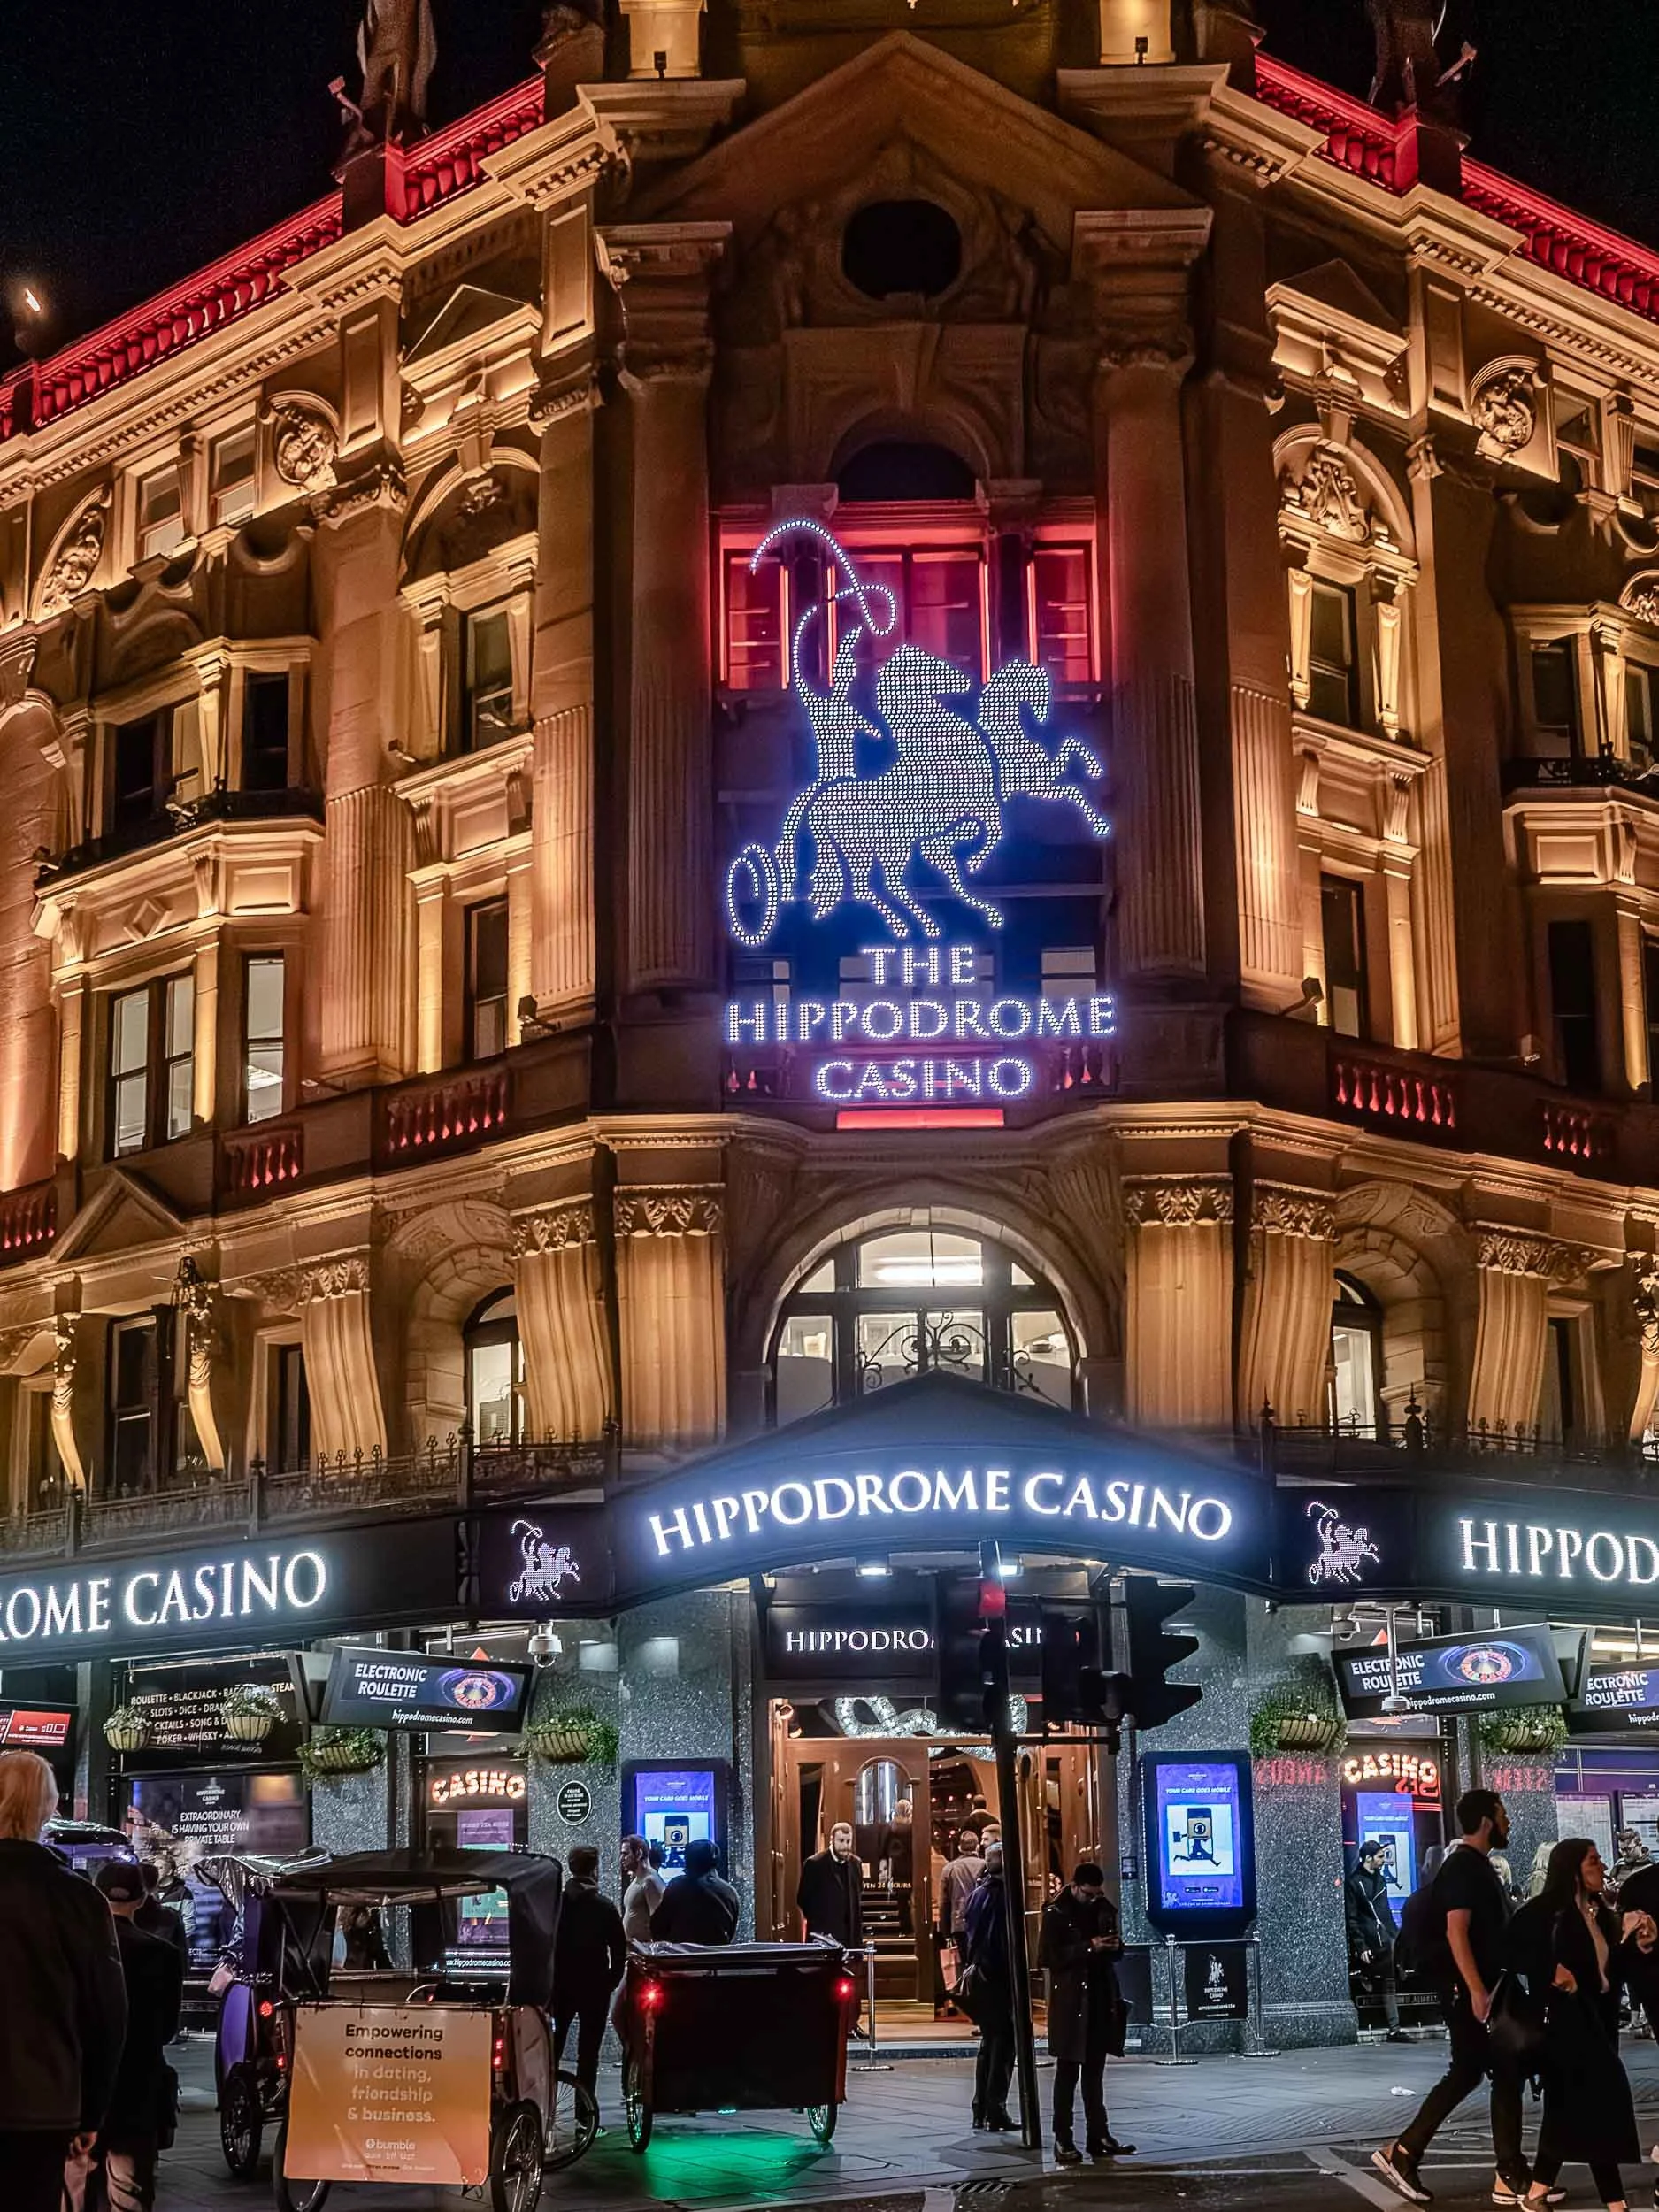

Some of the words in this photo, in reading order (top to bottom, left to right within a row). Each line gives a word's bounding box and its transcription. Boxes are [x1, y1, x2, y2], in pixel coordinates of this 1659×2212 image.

[863, 945, 975, 985] THE
[728, 996, 1116, 1041] HIPPODROME
[815, 1057, 1032, 1100] CASINO
[649, 1470, 1011, 1556] HIPPODROME
[1025, 1472, 1233, 1540] CASINO
[0, 1578, 112, 1641] OME
[124, 1551, 326, 1626] CASINO
[787, 1629, 934, 1652] HIPPODRO
[355, 1663, 427, 1682] ELECTRONIC
[131, 1692, 168, 1706] ROULETTE
[173, 1688, 218, 1704] BLACKJACK
[358, 1681, 418, 1698] ROULETTE
[1585, 1688, 1646, 1706] ROULETTE
[150, 1707, 173, 1717] SLOTS
[179, 1704, 197, 1715] DICE
[392, 1709, 473, 1724] hippodromecasino.com
[190, 1717, 212, 1728] SONG
[213, 1717, 219, 1726] &
[157, 1734, 182, 1745] POKER
[188, 1731, 219, 1742] WHISKY
[1344, 1753, 1438, 1783] CASINO
[430, 1770, 526, 1803] CASINO
[180, 1809, 241, 1822] EXTRAORDINARY
[171, 1824, 179, 1834] IS
[179, 1823, 208, 1833] HAVING
[207, 1822, 229, 1833] YOUR
[230, 1821, 250, 1832] OWN
[184, 1834, 213, 1845] PRIVATE
[214, 1833, 236, 1844] TABLE
[345, 2024, 443, 2041] Empowering
[345, 2046, 442, 2061] connections
[354, 2064, 368, 2079] in
[373, 2064, 432, 2083] dating,
[351, 2085, 433, 2104] friendship
[347, 2107, 357, 2121] &
[362, 2107, 436, 2122] business.
[376, 2138, 416, 2150] bumble
